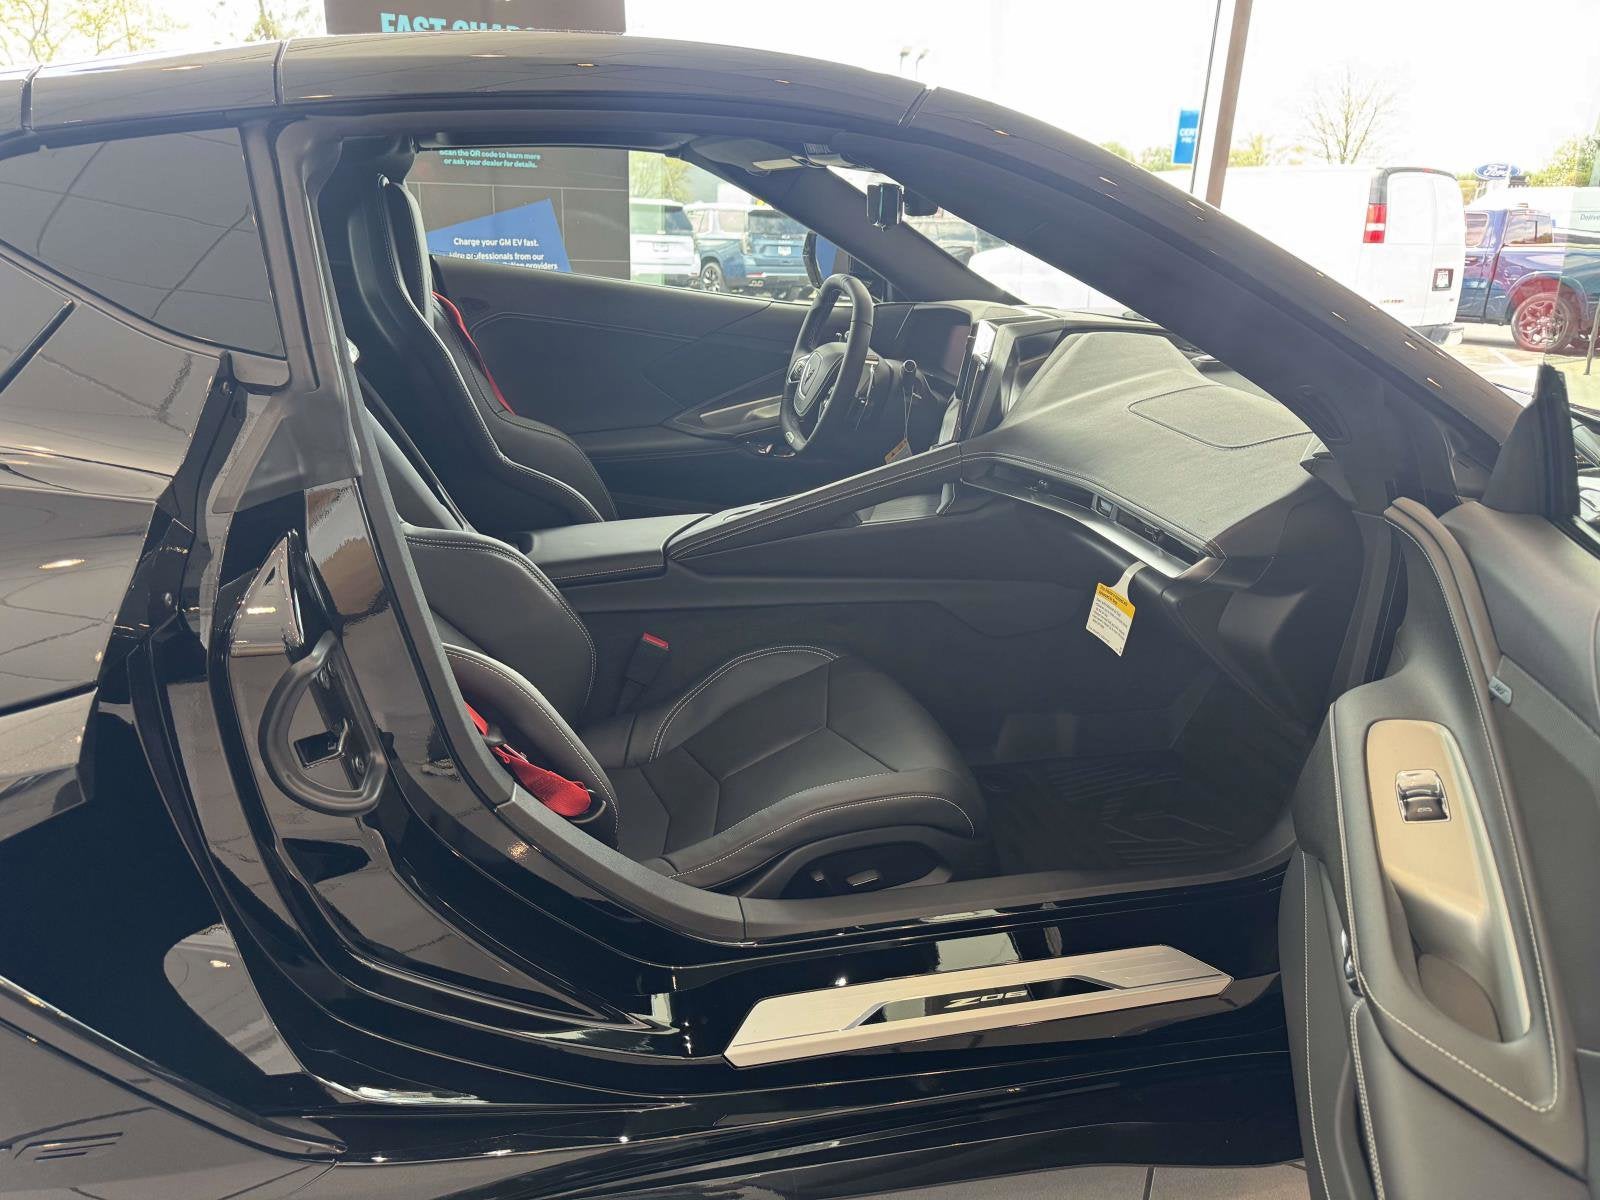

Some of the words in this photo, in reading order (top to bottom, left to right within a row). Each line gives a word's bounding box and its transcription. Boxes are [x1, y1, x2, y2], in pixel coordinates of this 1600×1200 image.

[457, 149, 469, 157] the
[469, 149, 481, 157] QR
[481, 150, 498, 158] code
[452, 158, 465, 166] ask
[465, 159, 481, 167] your
[481, 159, 503, 167] dealer
[503, 160, 514, 168] for
[514, 160, 538, 168] details.
[453, 237, 480, 247] Charge
[481, 239, 498, 247] your
[499, 238, 511, 247] GM
[512, 239, 523, 247] EV
[523, 238, 539, 247] fast.
[514, 251, 532, 260] from
[532, 253, 545, 261] our
[944, 990, 1028, 1008] Z06
